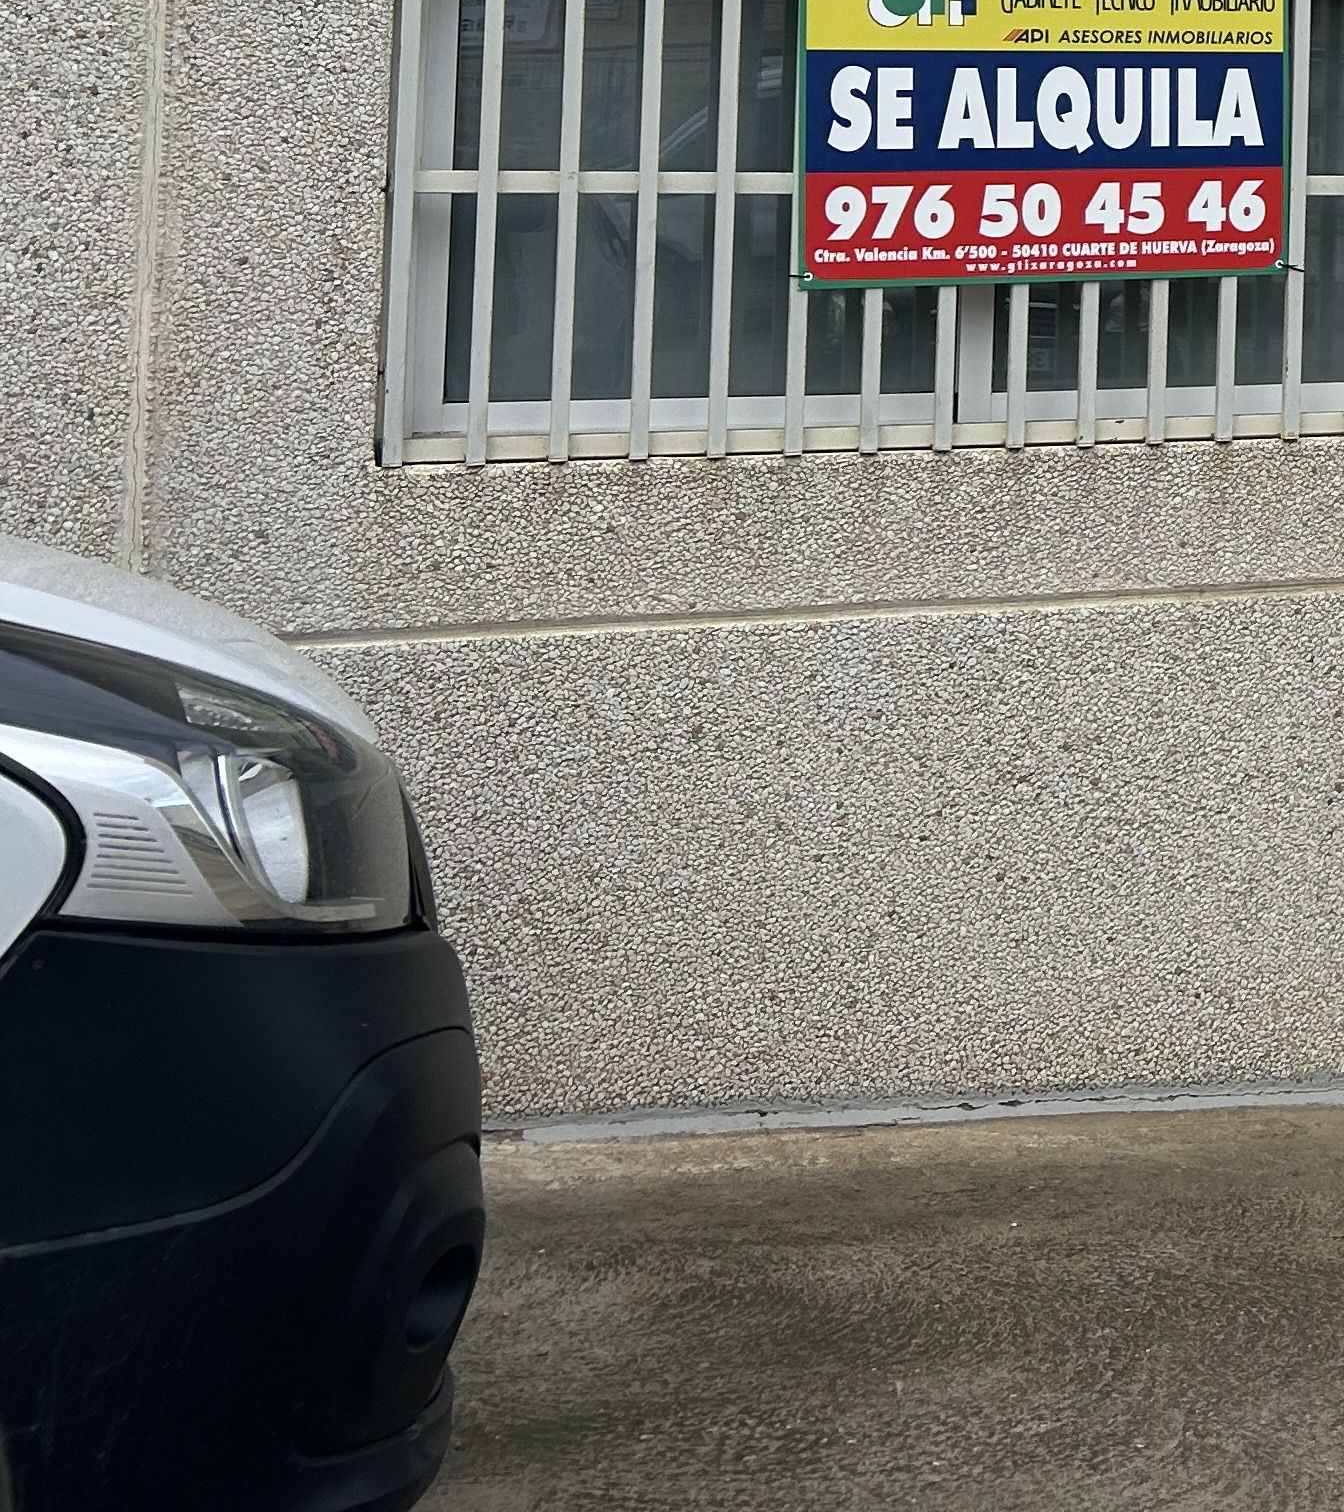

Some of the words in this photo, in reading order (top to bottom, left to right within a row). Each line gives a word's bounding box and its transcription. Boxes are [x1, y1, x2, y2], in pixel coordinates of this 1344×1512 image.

[1013, 28, 1050, 44] API
[1058, 30, 1142, 44] ASESORES
[1148, 30, 1273, 45] INMOBILIARIOS
[827, 65, 915, 153] SE
[937, 65, 1265, 154] ALQUILA
[824, 184, 955, 241] 976
[979, 182, 1062, 238] 50
[1084, 182, 1165, 235] 45
[1187, 179, 1267, 233] 46
[814, 247, 851, 263] Ctra.
[854, 247, 919, 262] Valencia
[921, 246, 951, 260] Km.
[1012, 243, 1058, 258] 50410
[1062, 242, 1115, 257] CUARTE
[1118, 241, 1138, 256] DE
[1141, 240, 1198, 255] HUERVA
[1201, 238, 1275, 255] (Zaragoza)
[965, 258, 1137, 273] www.gtizaragoza.com
